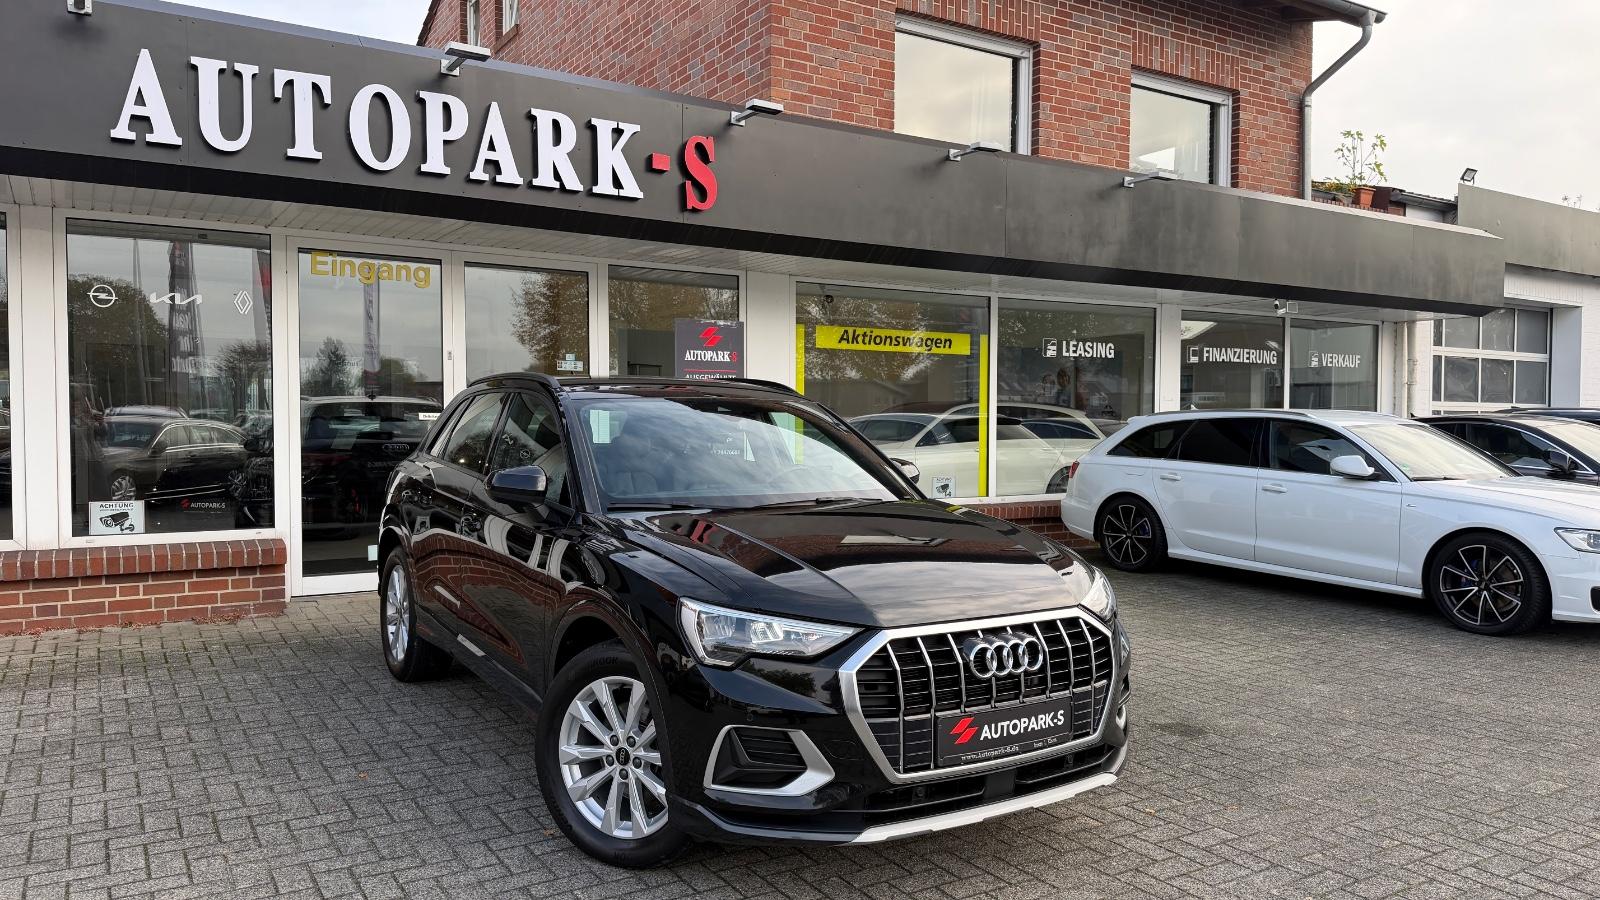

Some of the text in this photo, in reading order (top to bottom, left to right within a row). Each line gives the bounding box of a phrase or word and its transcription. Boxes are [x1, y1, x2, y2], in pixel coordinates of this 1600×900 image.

[109, 47, 719, 212] AUTOPARK-S
[310, 251, 432, 289] Eingang
[838, 329, 953, 351] Aktionswagen
[1062, 340, 1115, 359] LEASING
[684, 349, 737, 362] AUTOPARK-S
[1203, 347, 1278, 365] FINANZIERUNG
[1321, 353, 1361, 368] VERKAUF
[190, 501, 226, 509] AUTOPARK-S
[979, 709, 1065, 741] AUTOPARK-S
